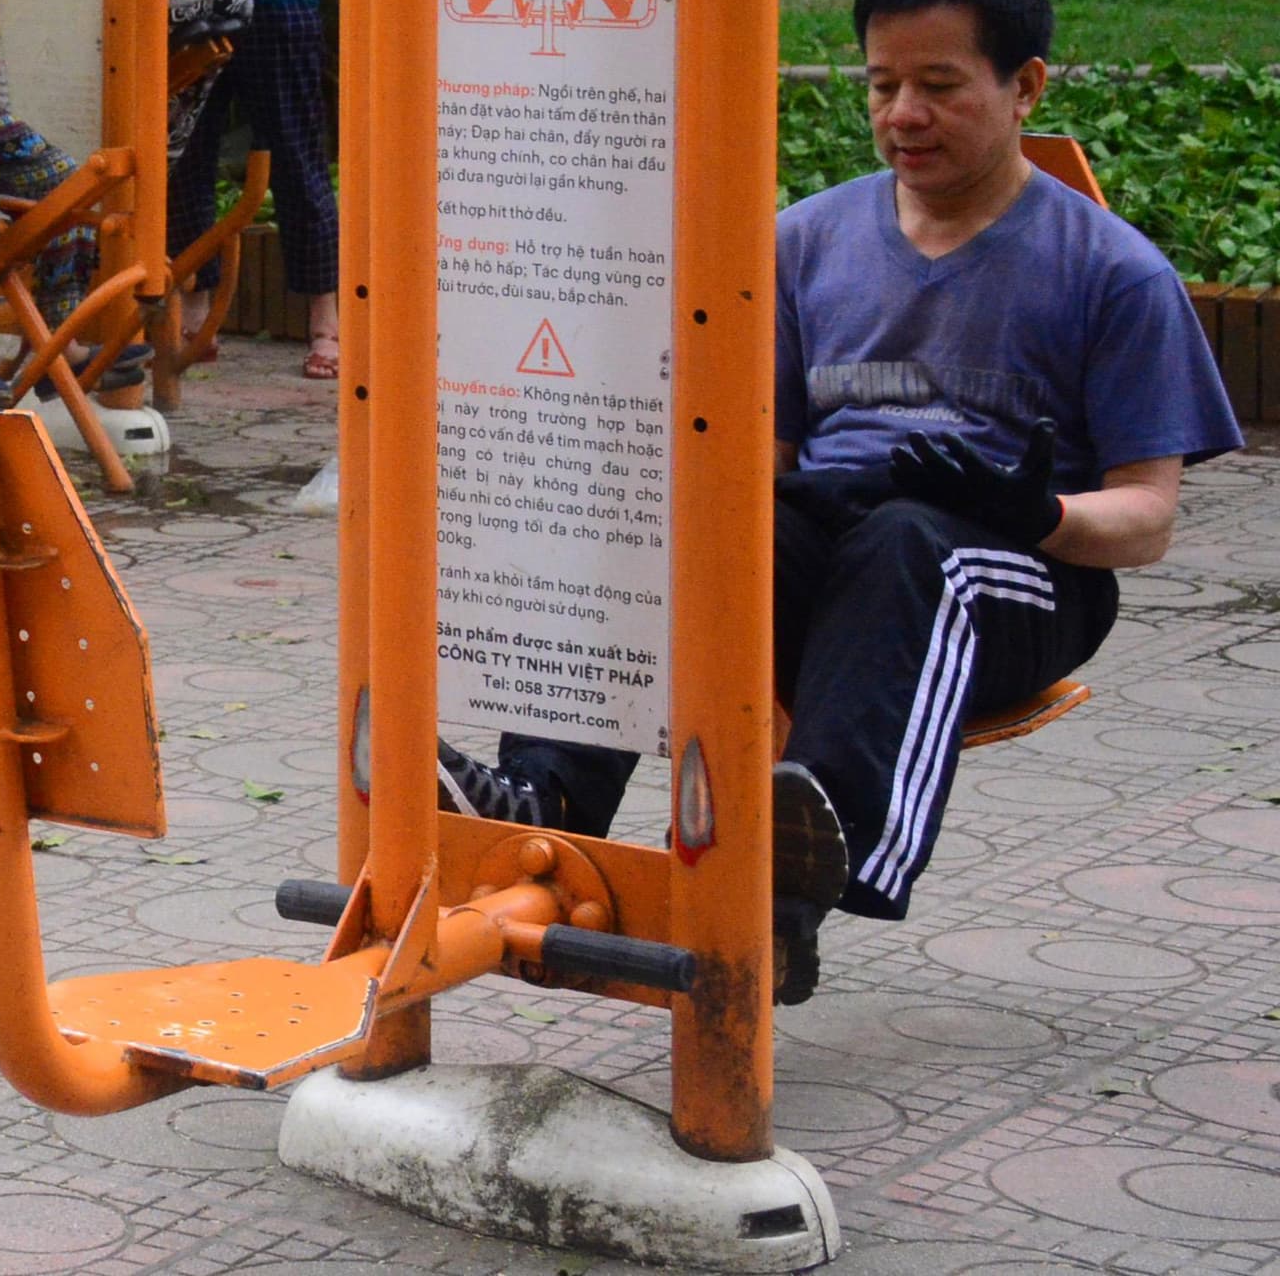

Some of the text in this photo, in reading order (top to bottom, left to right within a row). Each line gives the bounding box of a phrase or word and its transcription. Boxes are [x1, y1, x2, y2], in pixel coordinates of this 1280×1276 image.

[645, 89, 666, 103] hai
[524, 106, 544, 119] hai
[505, 126, 524, 141] hai
[652, 138, 665, 148] ra
[453, 145, 496, 162] khung
[550, 153, 567, 165] co
[612, 155, 633, 169] hai
[578, 174, 627, 195] khung.
[523, 386, 569, 406] Không
[558, 435, 580, 449] tim
[534, 472, 578, 496] không
[635, 488, 663, 502] cho
[470, 490, 490, 504] nhi
[557, 501, 582, 515] cao
[438, 530, 476, 548] 00kg.
[573, 523, 599, 539] cho
[475, 570, 489, 582] xa
[463, 589, 482, 603] khi
[466, 625, 508, 644] phẩm
[513, 632, 552, 650] được
[557, 640, 582, 655] sản
[588, 643, 622, 660] xuất
[438, 642, 654, 688] CÔNG TY TNHH VIỆT PHÁP
[482, 674, 606, 704] Tel: 058 3771379
[469, 697, 620, 730] www.vifasport.com
